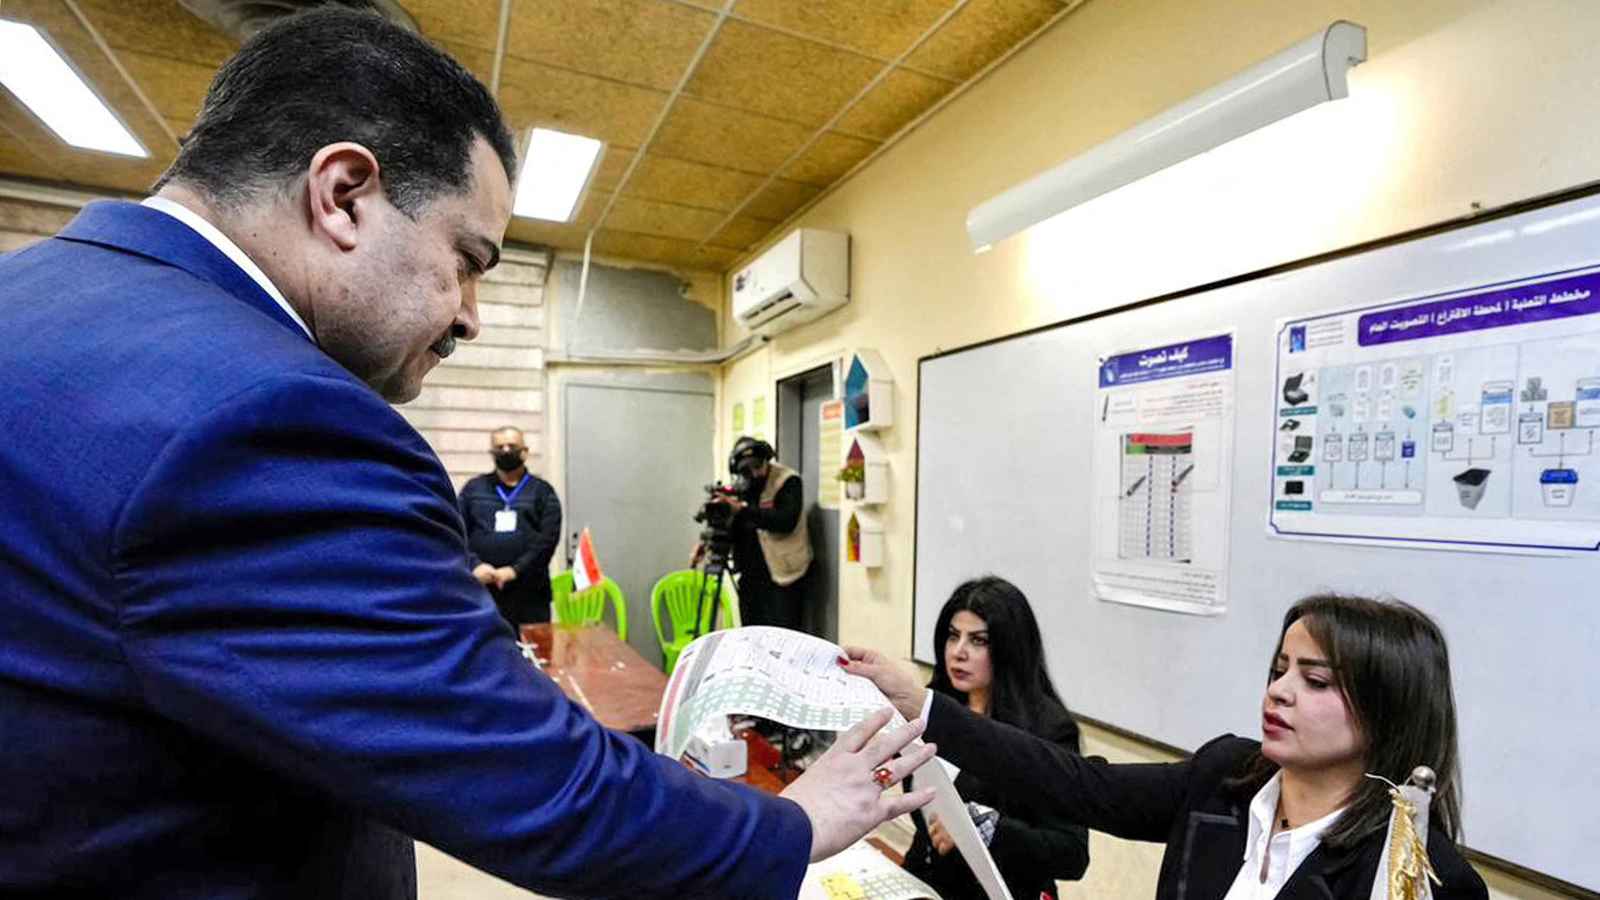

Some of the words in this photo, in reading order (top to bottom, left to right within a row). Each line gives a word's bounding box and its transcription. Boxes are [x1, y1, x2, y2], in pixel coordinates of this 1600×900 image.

[1549, 288, 1591, 304] مخطط
[1389, 314, 1429, 331] التصويت
[1437, 307, 1471, 326] الاقتراع
[1138, 350, 1167, 368] تصوت
[1168, 346, 1189, 363] كيف
